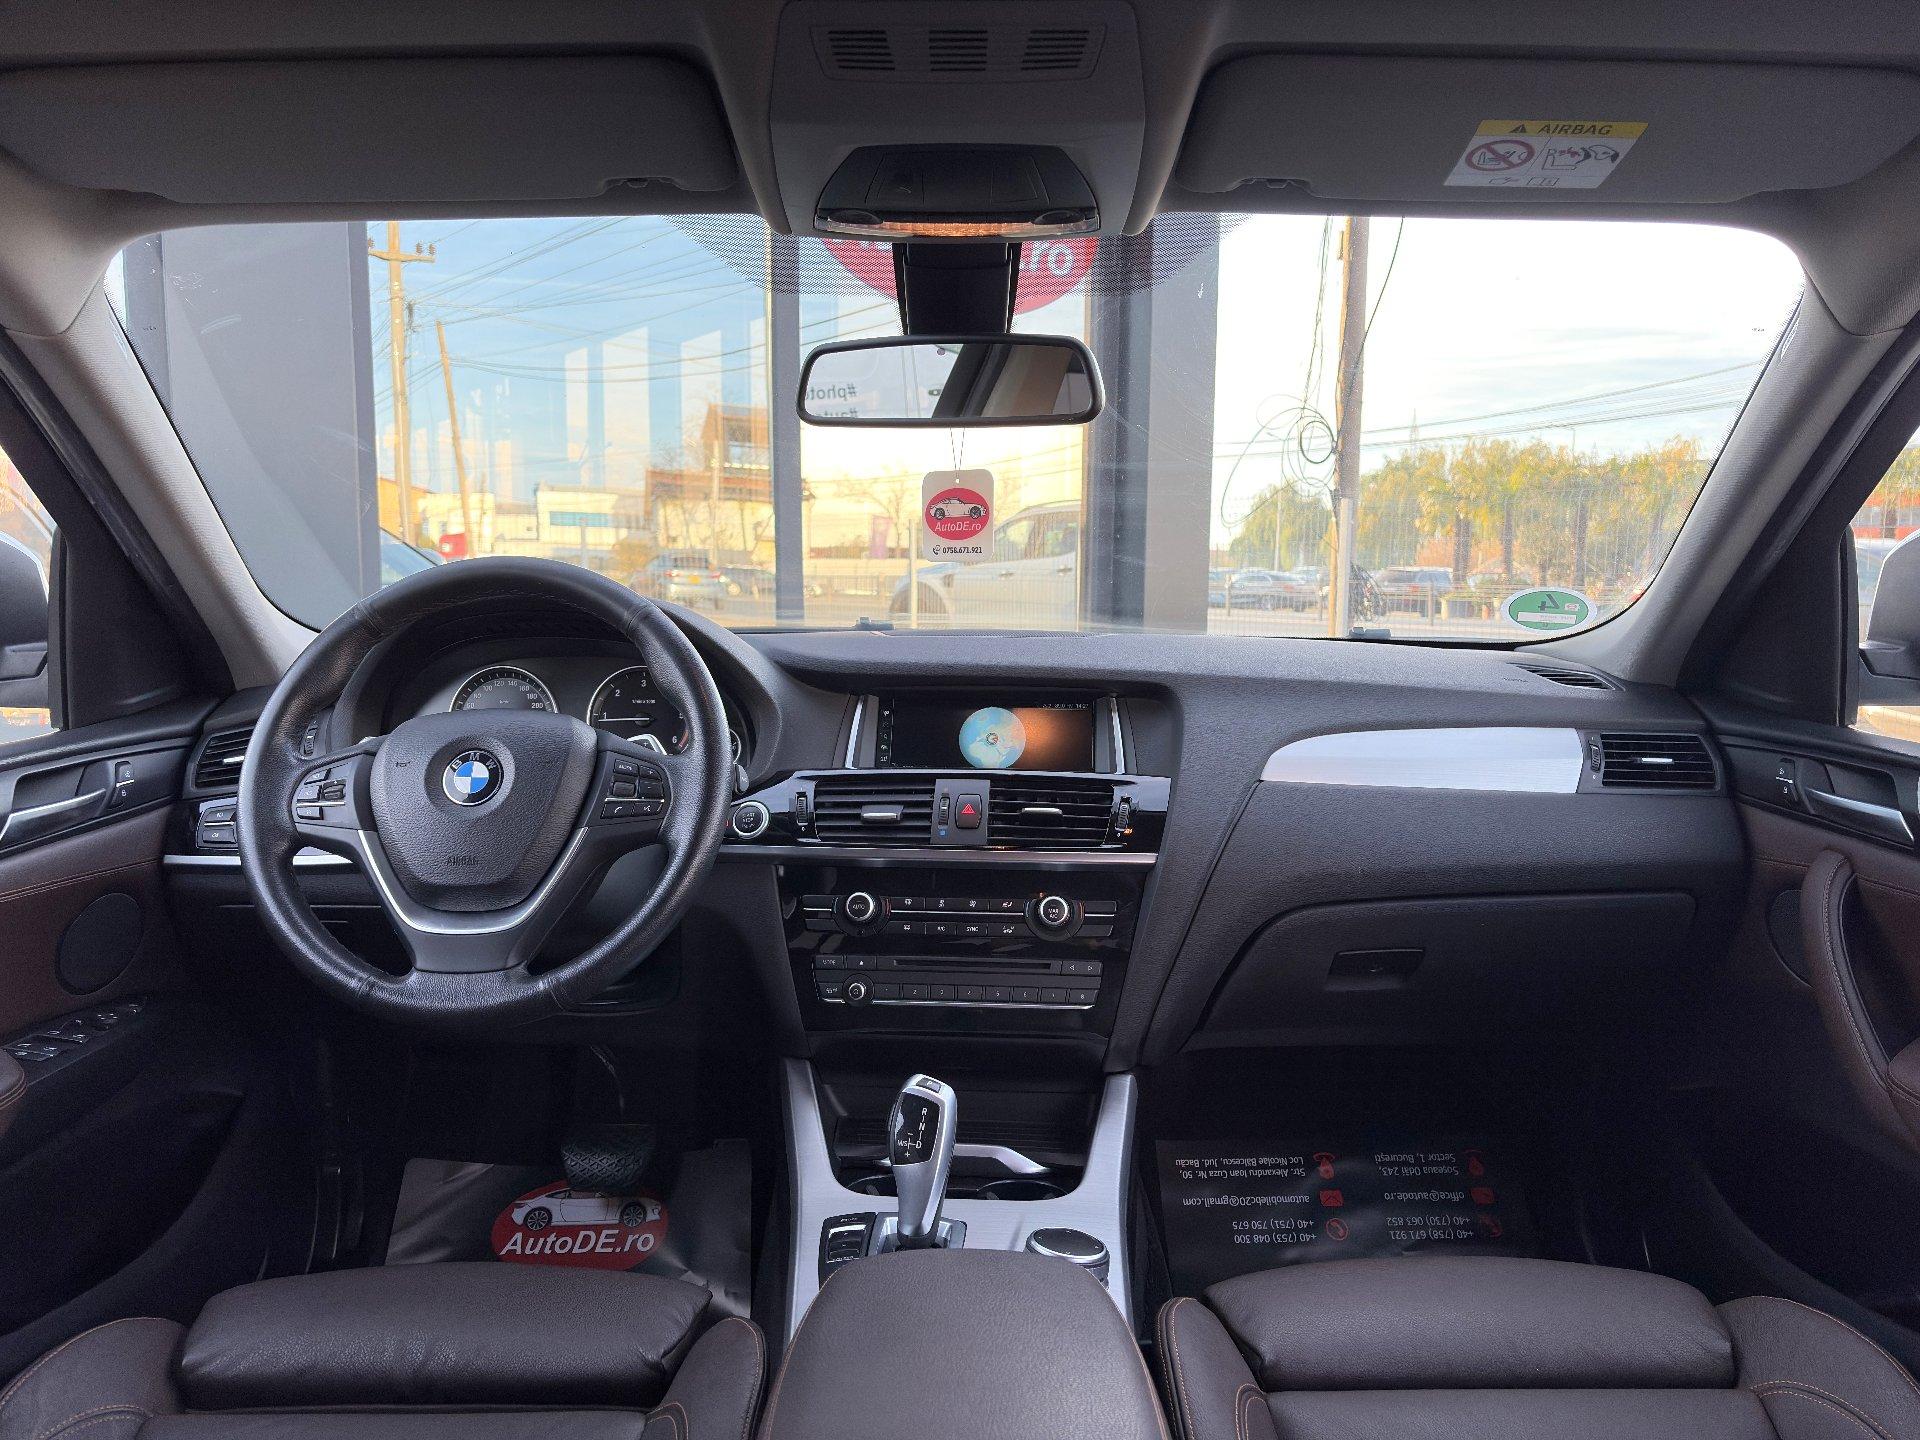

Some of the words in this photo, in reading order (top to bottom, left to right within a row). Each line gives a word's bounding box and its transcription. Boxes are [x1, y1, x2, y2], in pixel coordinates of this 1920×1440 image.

[1537, 124, 1613, 135] AIRBAG
[934, 521, 982, 532] AutoDE.ro
[942, 546, 983, 554] 0758.671.921
[641, 679, 647, 687] 3
[614, 689, 621, 697] 2
[671, 736, 678, 744] 6
[450, 752, 497, 770] BMW
[921, 1107, 928, 1116] R
[918, 1122, 926, 1131] N
[915, 1140, 922, 1149] D
[1202, 1158, 1217, 1166] Jud.
[1259, 1157, 1287, 1165] Nicolae
[1290, 1156, 1303, 1165] Loc
[1428, 1153, 1455, 1162] Sector
[1179, 1170, 1192, 1179] 50,
[1196, 1170, 1207, 1178] Nr.
[1209, 1170, 1228, 1178] Cuza
[1249, 1168, 1288, 1177] Alexandru
[1291, 1168, 1305, 1176] Str.
[1379, 1167, 1399, 1175] 243,
[1384, 1190, 1464, 1201] office@autode.ro
[1182, 1195, 1309, 1207] automobilebc20@gmail.com
[1232, 1221, 1248, 1229] 675
[1270, 1218, 1294, 1229] (751)
[1297, 1220, 1314, 1228] +40
[1454, 1216, 1470, 1225] +40
[1273, 1232, 1296, 1243] (753)
[1299, 1233, 1316, 1241] +40
[1389, 1230, 1407, 1239] 921
[1410, 1230, 1426, 1239] 671
[1429, 1228, 1453, 1239] (758)
[1457, 1230, 1473, 1238] +40
[499, 1229, 656, 1256] AutoDE.ro
[1234, 1234, 1250, 1244] 300
[1253, 1234, 1270, 1243] 048
